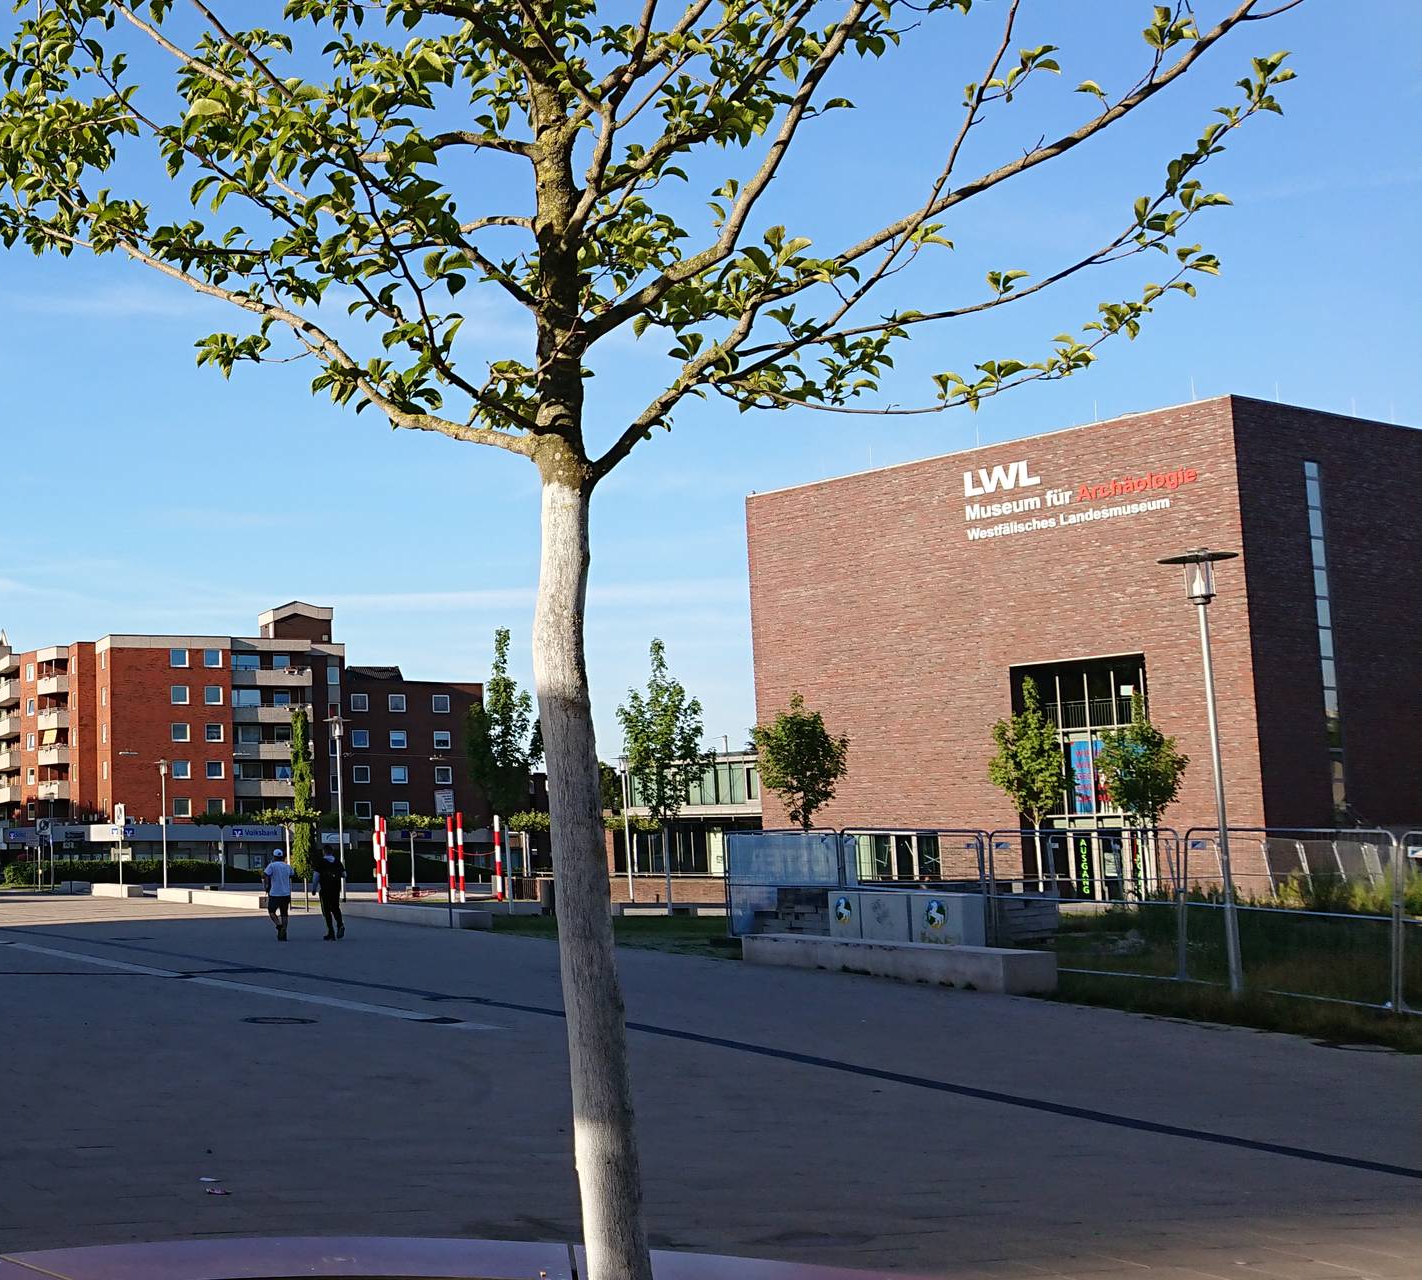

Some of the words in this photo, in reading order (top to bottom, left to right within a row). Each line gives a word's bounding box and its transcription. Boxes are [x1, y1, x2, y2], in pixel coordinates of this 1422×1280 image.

[963, 460, 1041, 497] LWL
[965, 495, 1041, 521] Museum
[1045, 489, 1073, 508] für
[1076, 466, 1197, 503] Archäologie
[966, 517, 1057, 541] Westfälisches
[1059, 498, 1171, 526] Landesmuseum
[1079, 838, 1091, 895] AUSGANG
